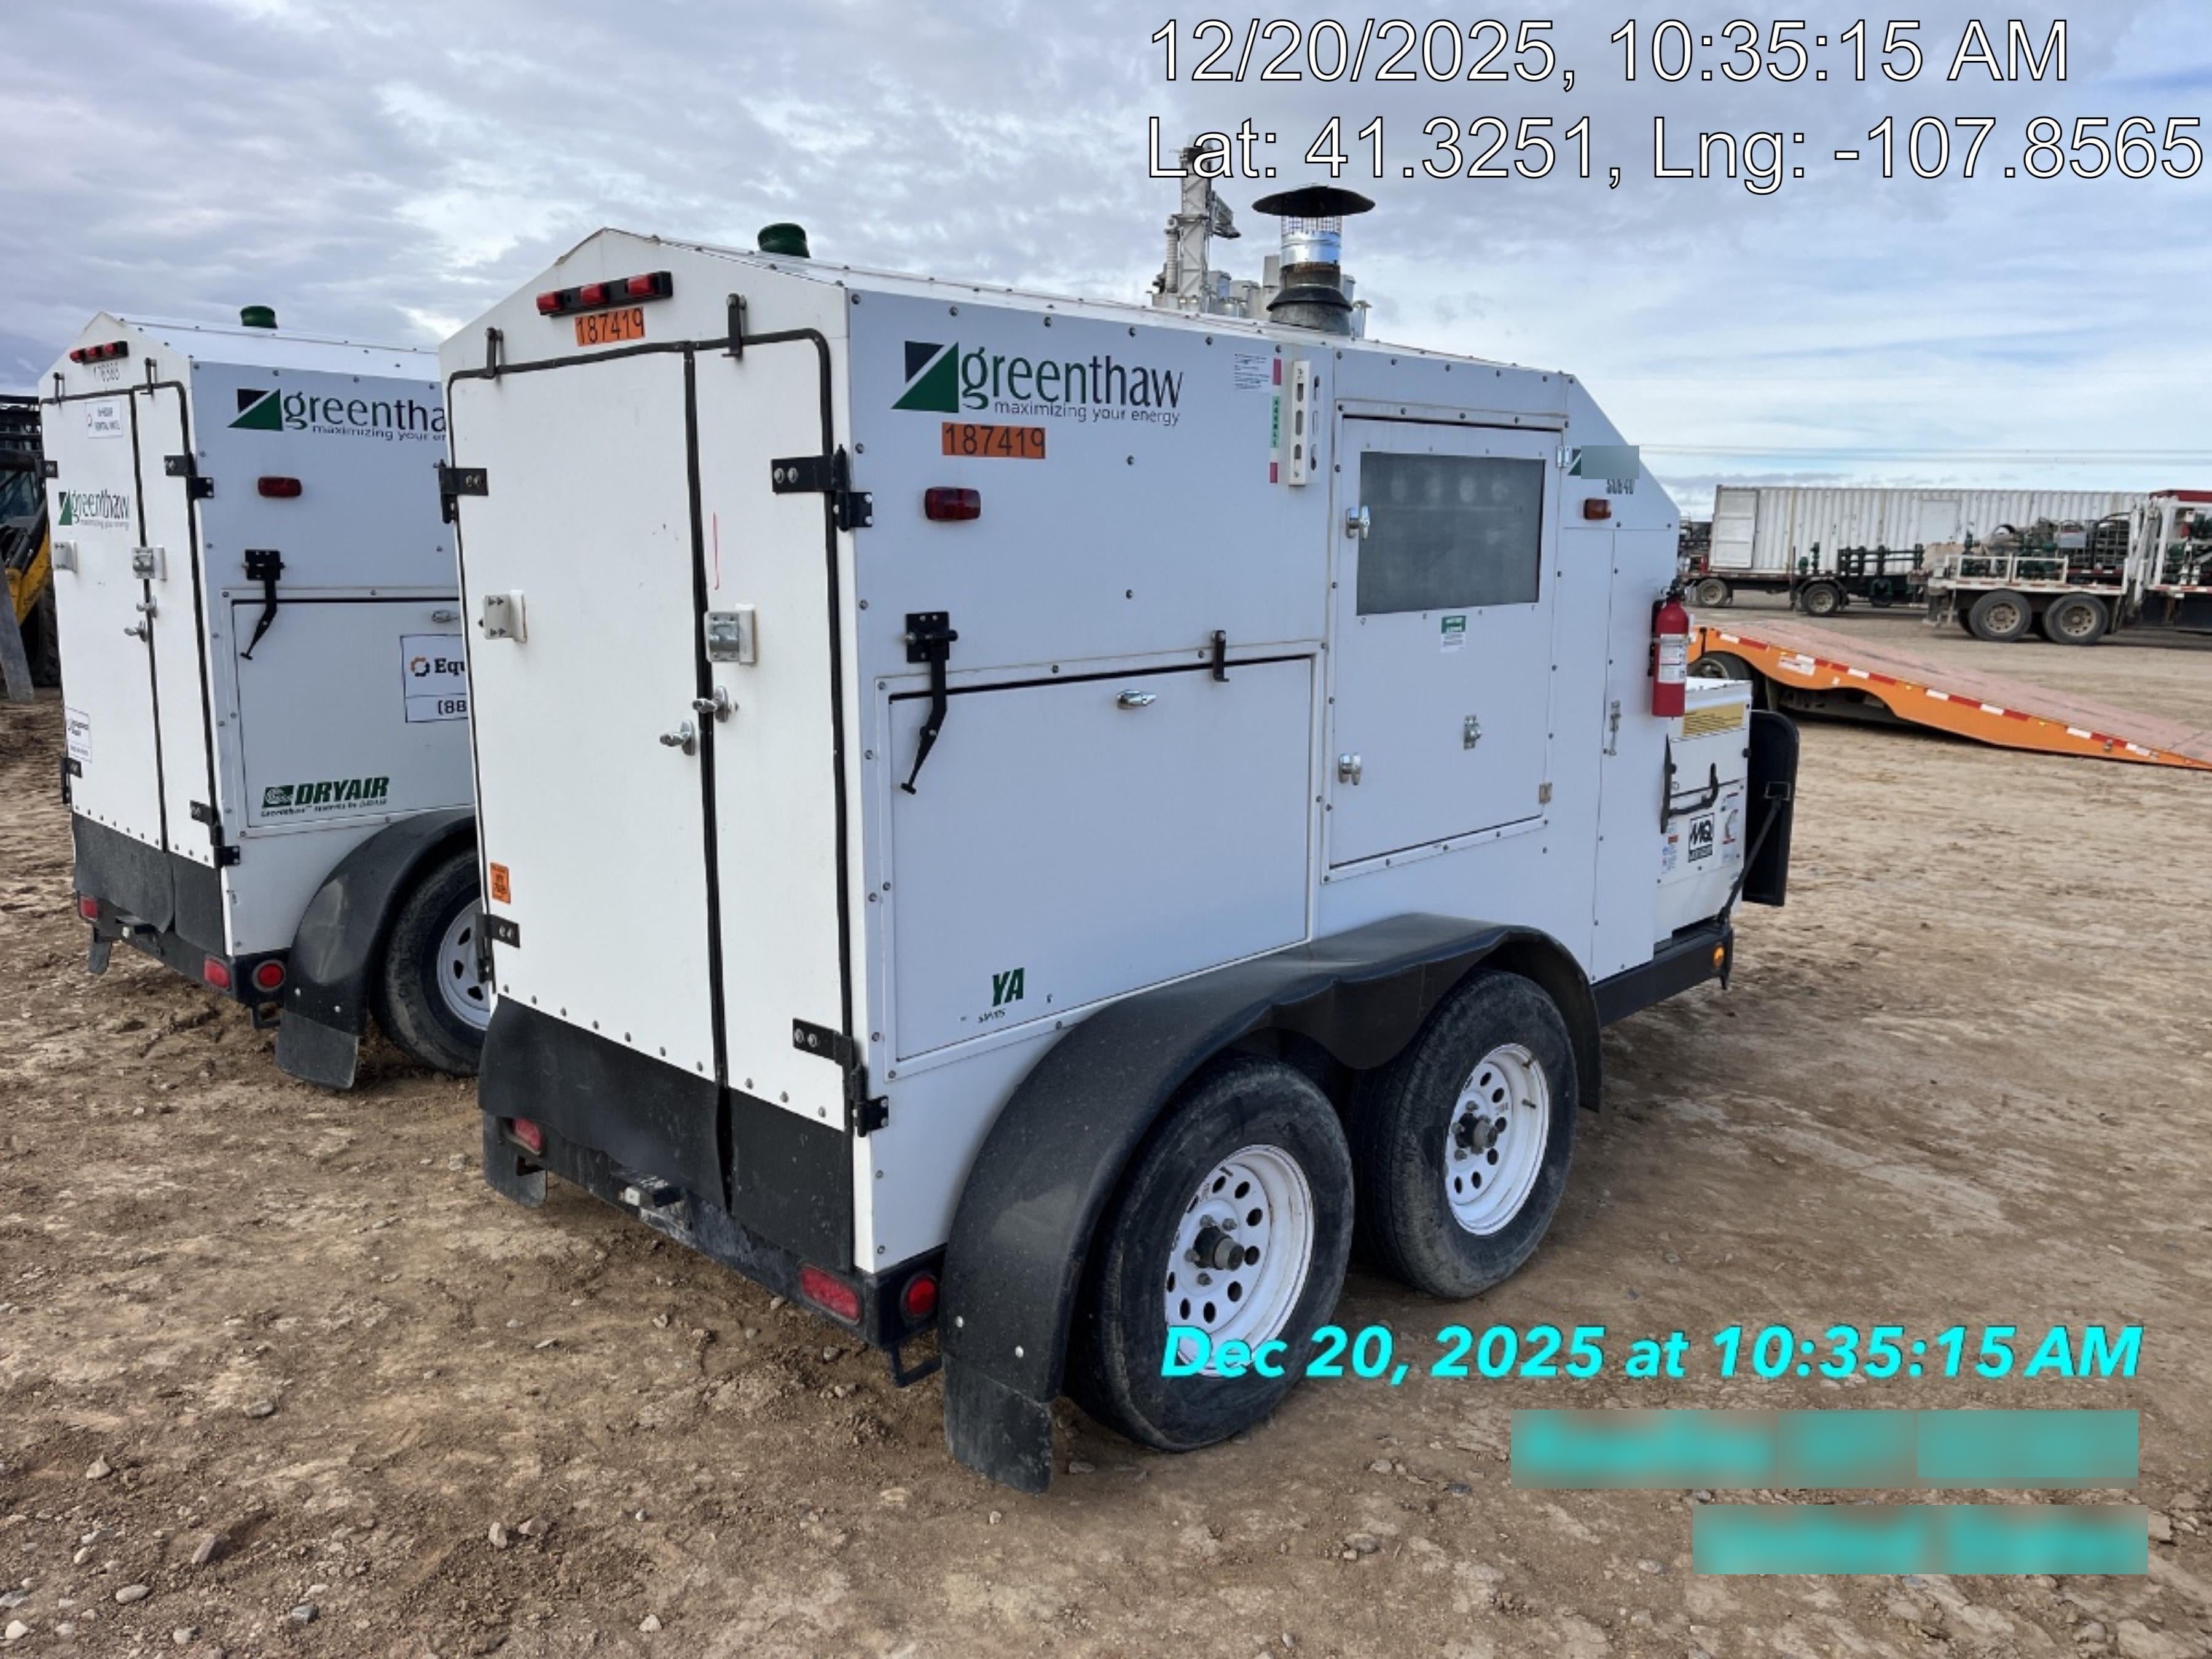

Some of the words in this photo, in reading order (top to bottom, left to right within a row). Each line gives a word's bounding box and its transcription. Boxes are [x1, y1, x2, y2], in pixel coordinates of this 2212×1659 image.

[576, 307, 645, 343] 187419
[961, 347, 1184, 410] greenthaw
[283, 391, 446, 432] greentha
[994, 401, 1087, 422] maximizing
[1092, 406, 1126, 422] your
[1131, 409, 1180, 426] energy
[312, 425, 394, 441] maximizing
[398, 430, 428, 441] your
[945, 424, 1045, 457] 187419
[72, 488, 129, 524] greenthaw
[294, 777, 390, 806] DRYAIR
[992, 967, 1025, 1007] YA
